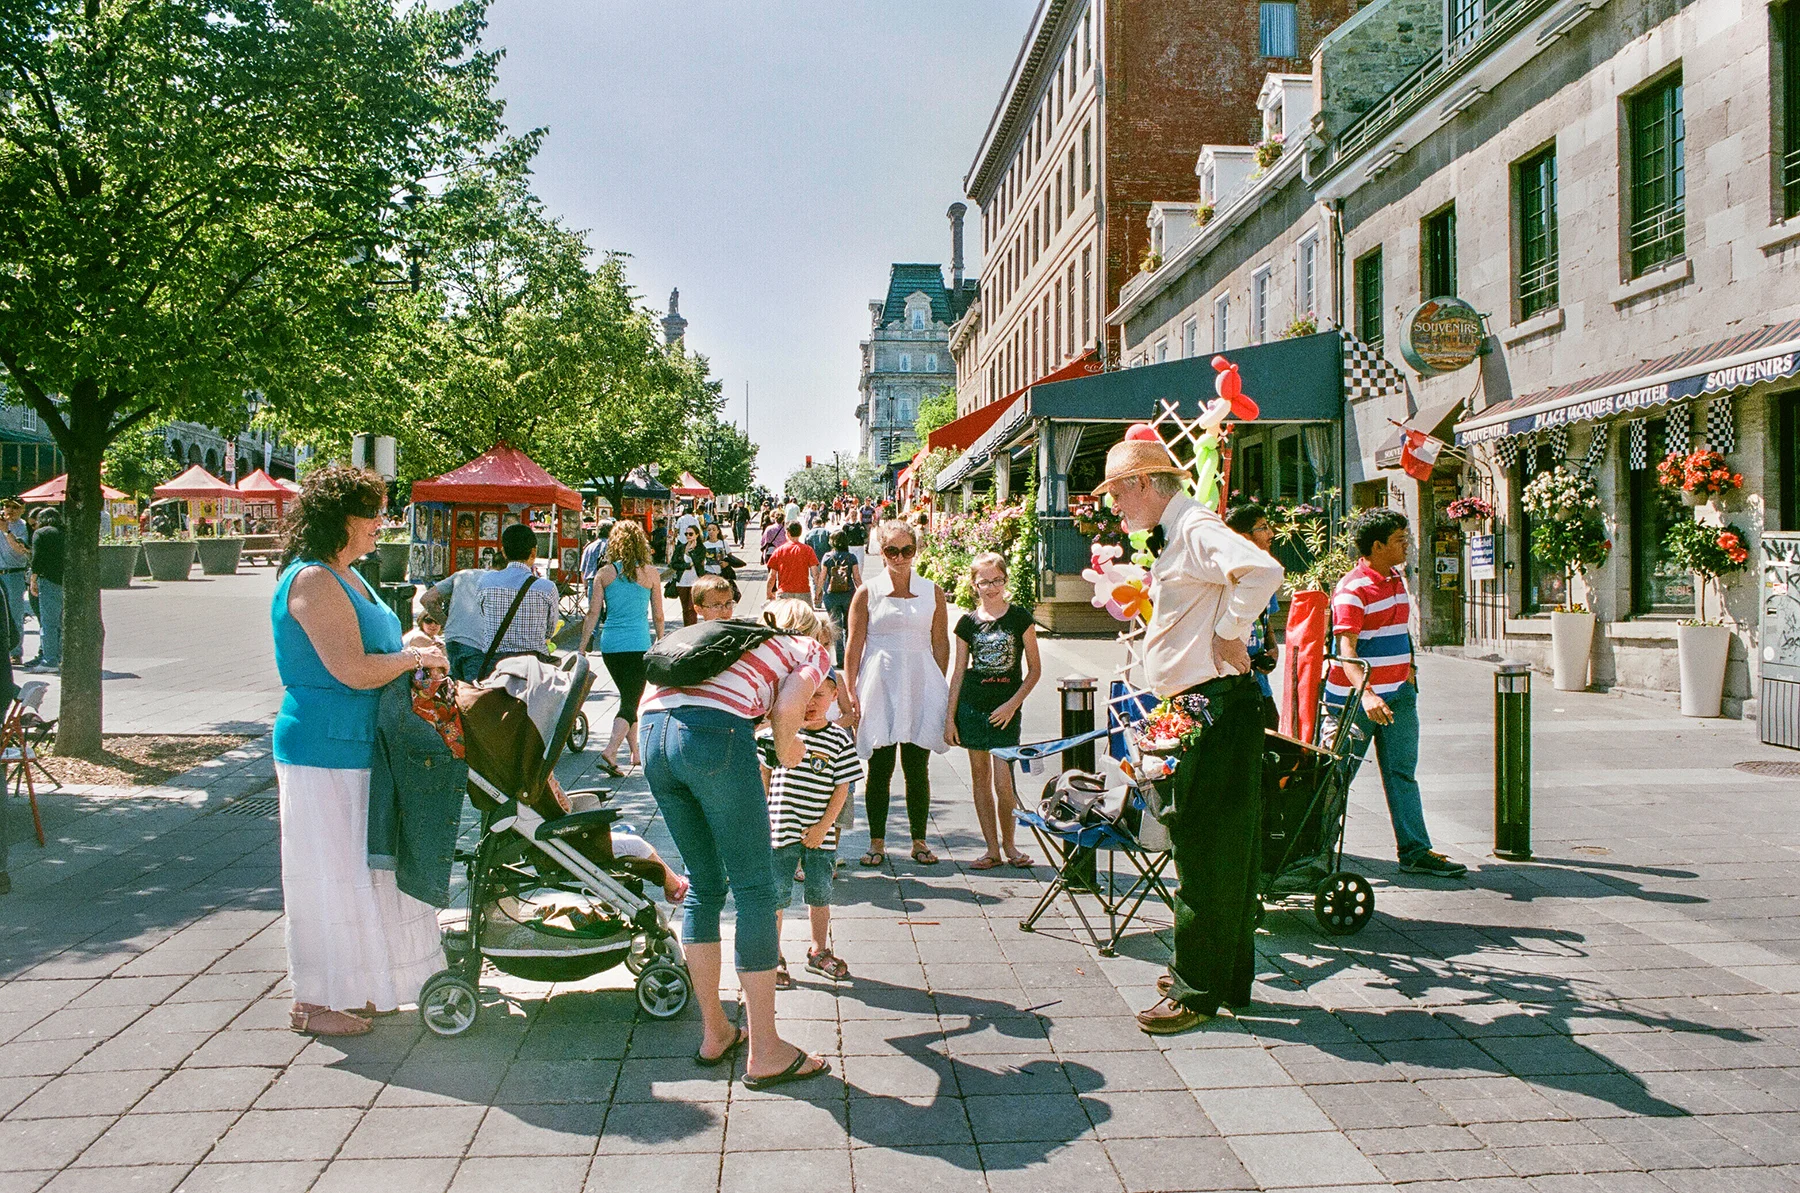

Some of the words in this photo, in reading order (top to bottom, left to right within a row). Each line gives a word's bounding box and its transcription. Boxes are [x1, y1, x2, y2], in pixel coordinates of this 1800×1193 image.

[1414, 322, 1478, 333] SOUVENIRS
[1461, 421, 1510, 444] SOUVENIRS
[1535, 408, 1566, 428] PLACE
[1567, 396, 1614, 420] JACQUES
[1615, 384, 1669, 409] CARTIER
[1705, 353, 1794, 388] SOUVENIRS
[1384, 448, 1402, 459] SOUVE
